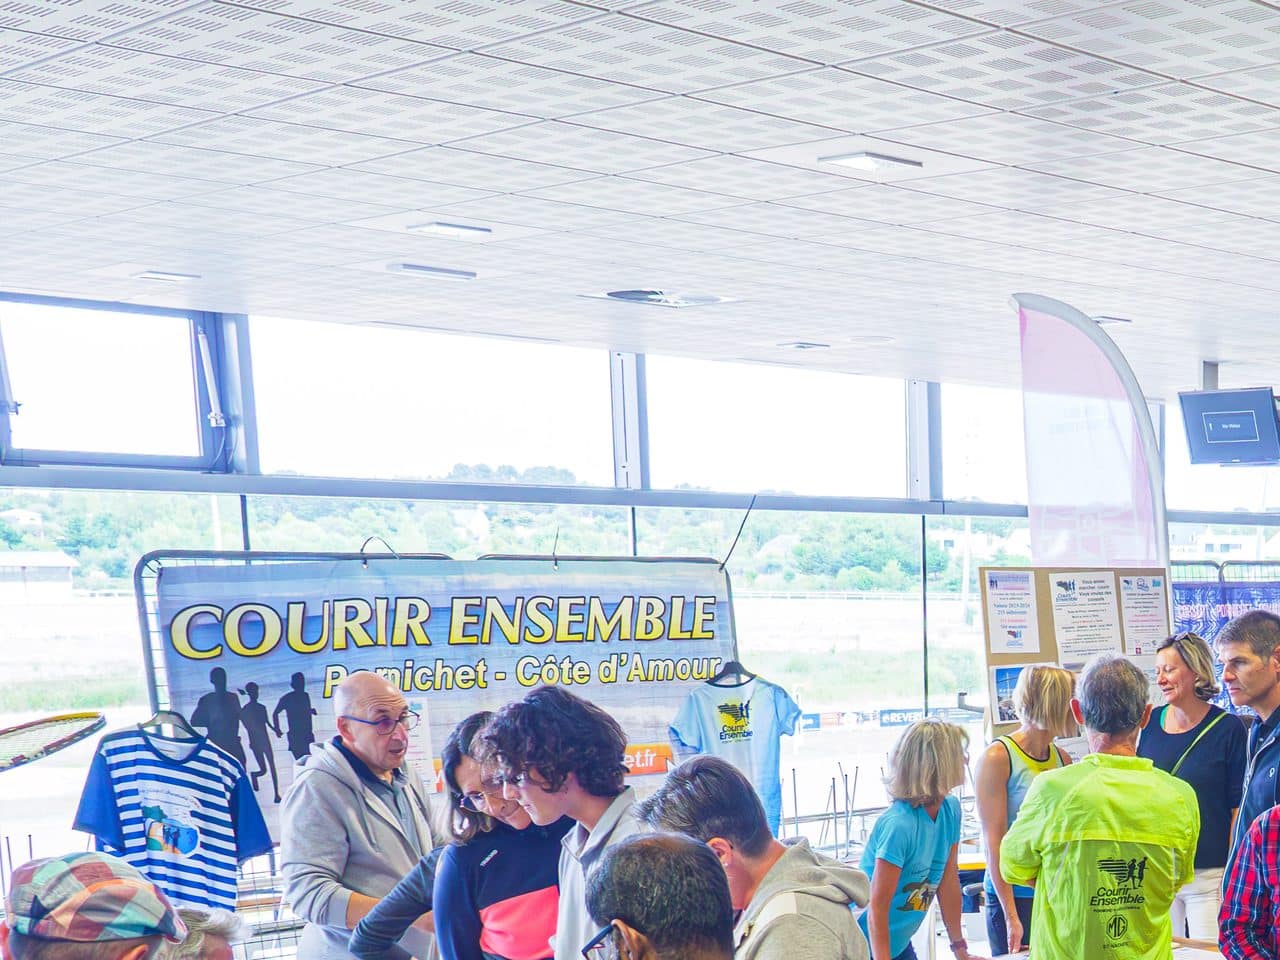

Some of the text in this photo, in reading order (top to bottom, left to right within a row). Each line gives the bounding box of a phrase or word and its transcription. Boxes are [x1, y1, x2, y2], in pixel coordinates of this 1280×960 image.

[170, 596, 717, 660] COURIR ENSEMBLE
[323, 658, 488, 698] Prnichet
[516, 654, 592, 687] Côte
[1090, 893, 1145, 906] Ensemble
[1096, 884, 1131, 897] Courir
[1108, 916, 1127, 938] MG
